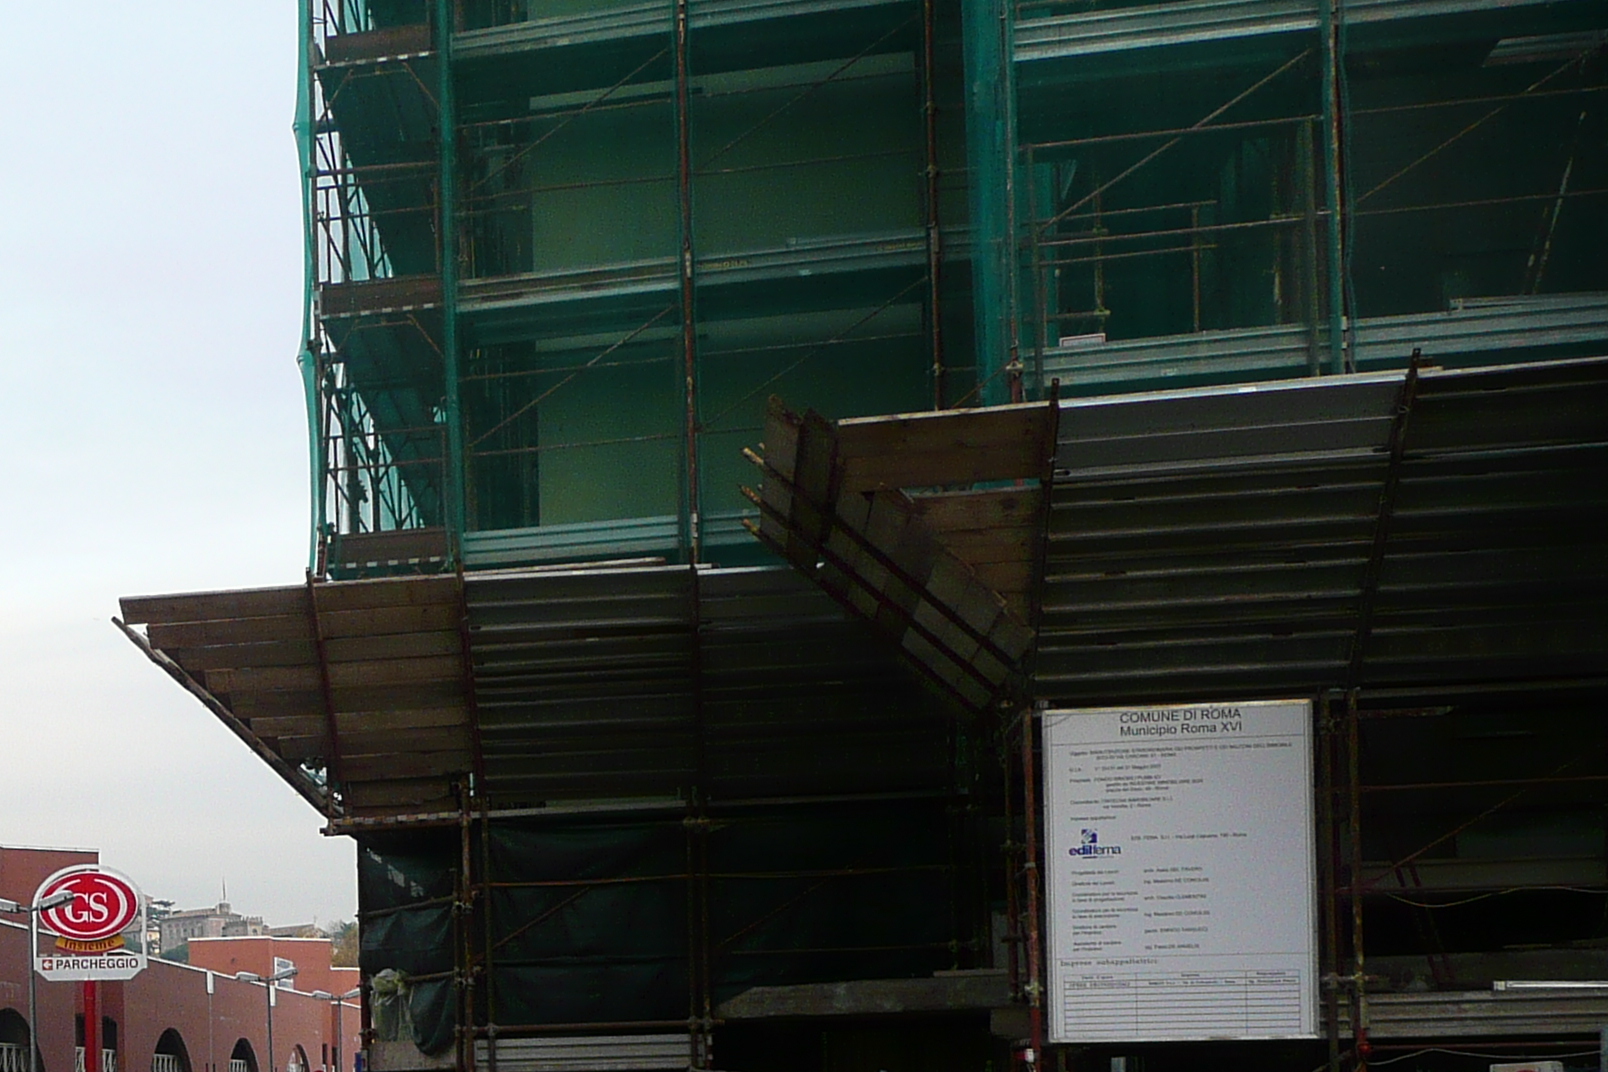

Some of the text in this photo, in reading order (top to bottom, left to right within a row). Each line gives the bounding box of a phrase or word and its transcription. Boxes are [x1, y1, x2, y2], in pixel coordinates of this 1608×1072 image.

[1120, 708, 1242, 724] COMUNE DI ROMA
[1120, 721, 1242, 737] Municipio Roma XVI
[63, 892, 109, 923] GS
[63, 939, 116, 951] Insieme
[55, 957, 139, 970] PARCHEGGIO
